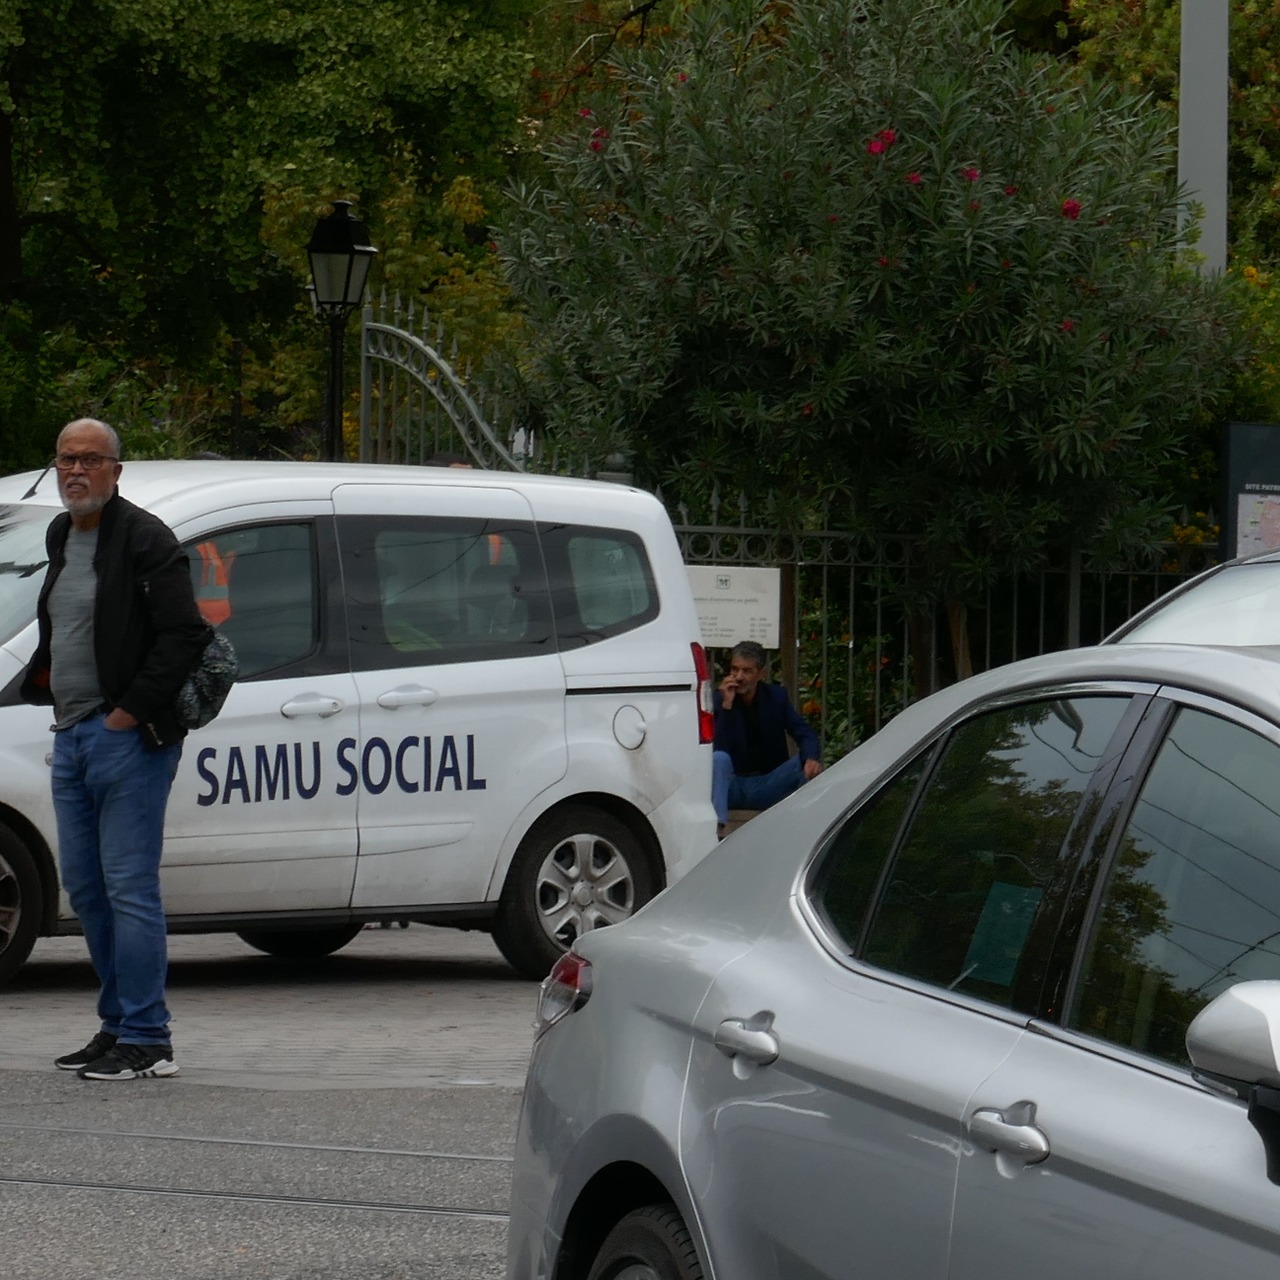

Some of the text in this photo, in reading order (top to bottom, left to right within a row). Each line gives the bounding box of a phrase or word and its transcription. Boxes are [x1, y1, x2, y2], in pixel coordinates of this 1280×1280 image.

[1245, 483, 1261, 491] SITE
[196, 734, 487, 806] SAMU SOCIAL
